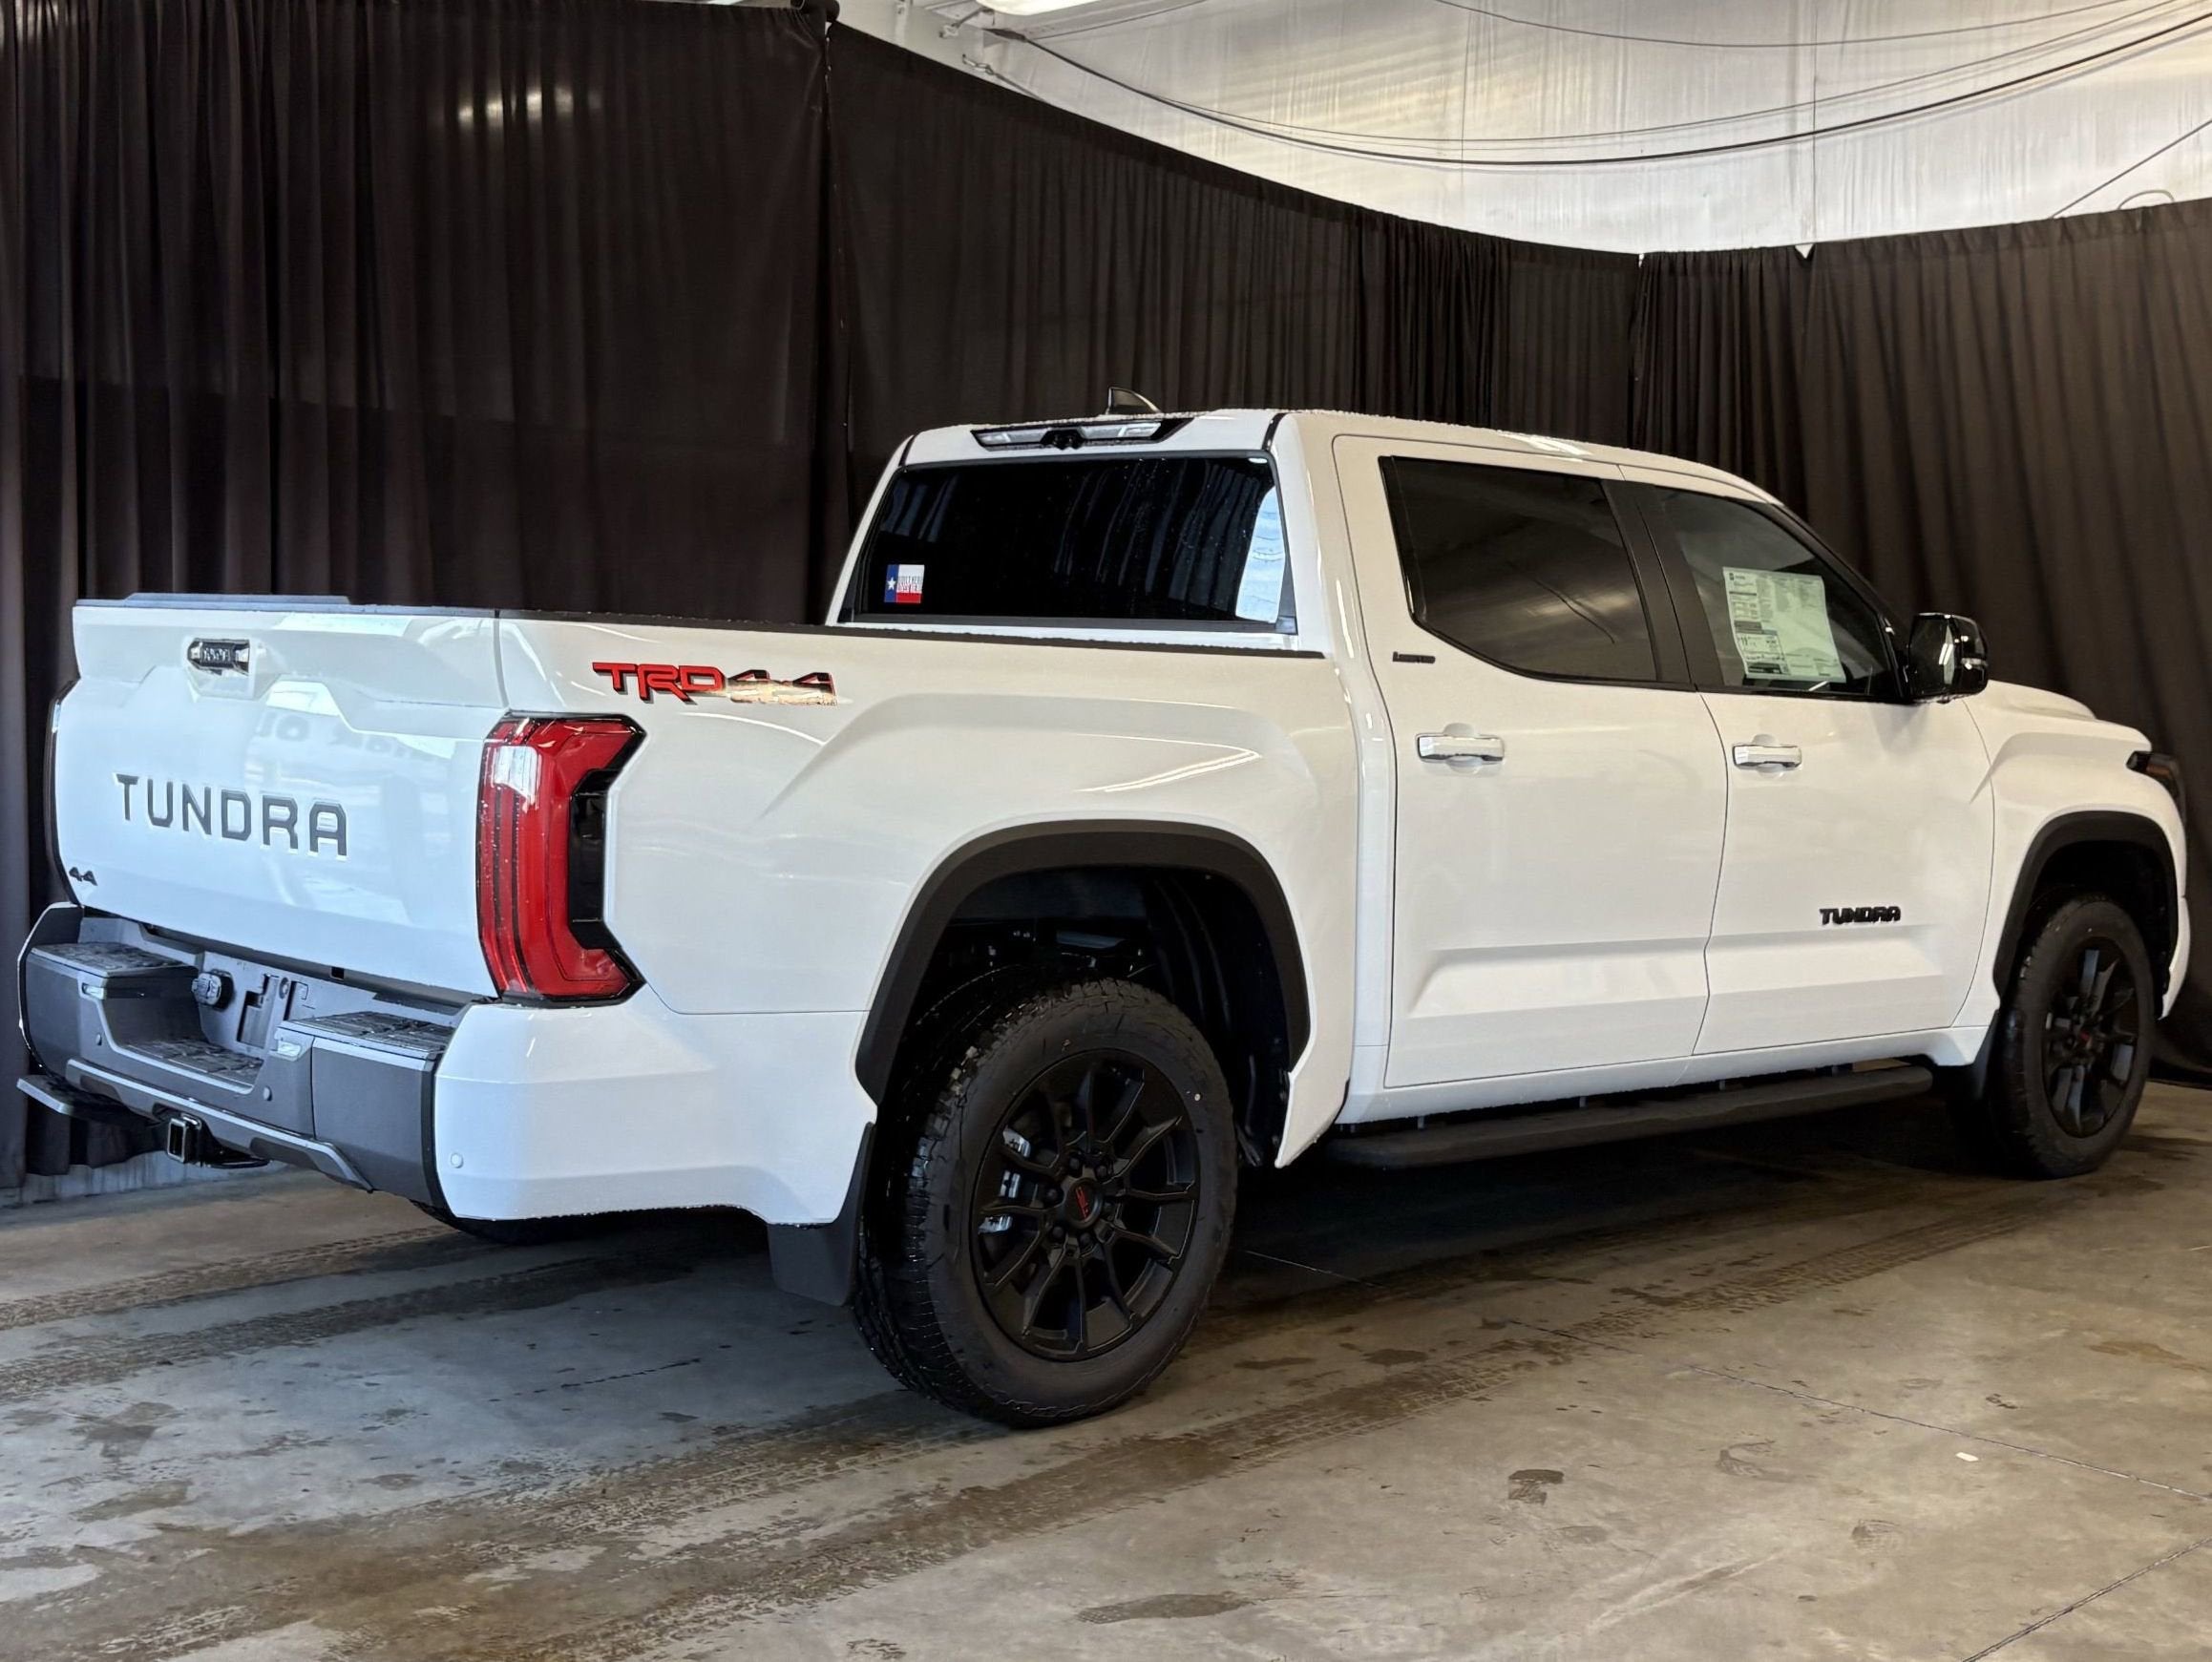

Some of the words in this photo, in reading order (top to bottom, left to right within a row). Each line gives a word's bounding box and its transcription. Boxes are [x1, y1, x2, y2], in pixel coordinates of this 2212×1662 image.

[592, 662, 726, 705] TRD
[115, 773, 348, 856] TUNDRA
[1819, 906, 1902, 925] TUNDRA
